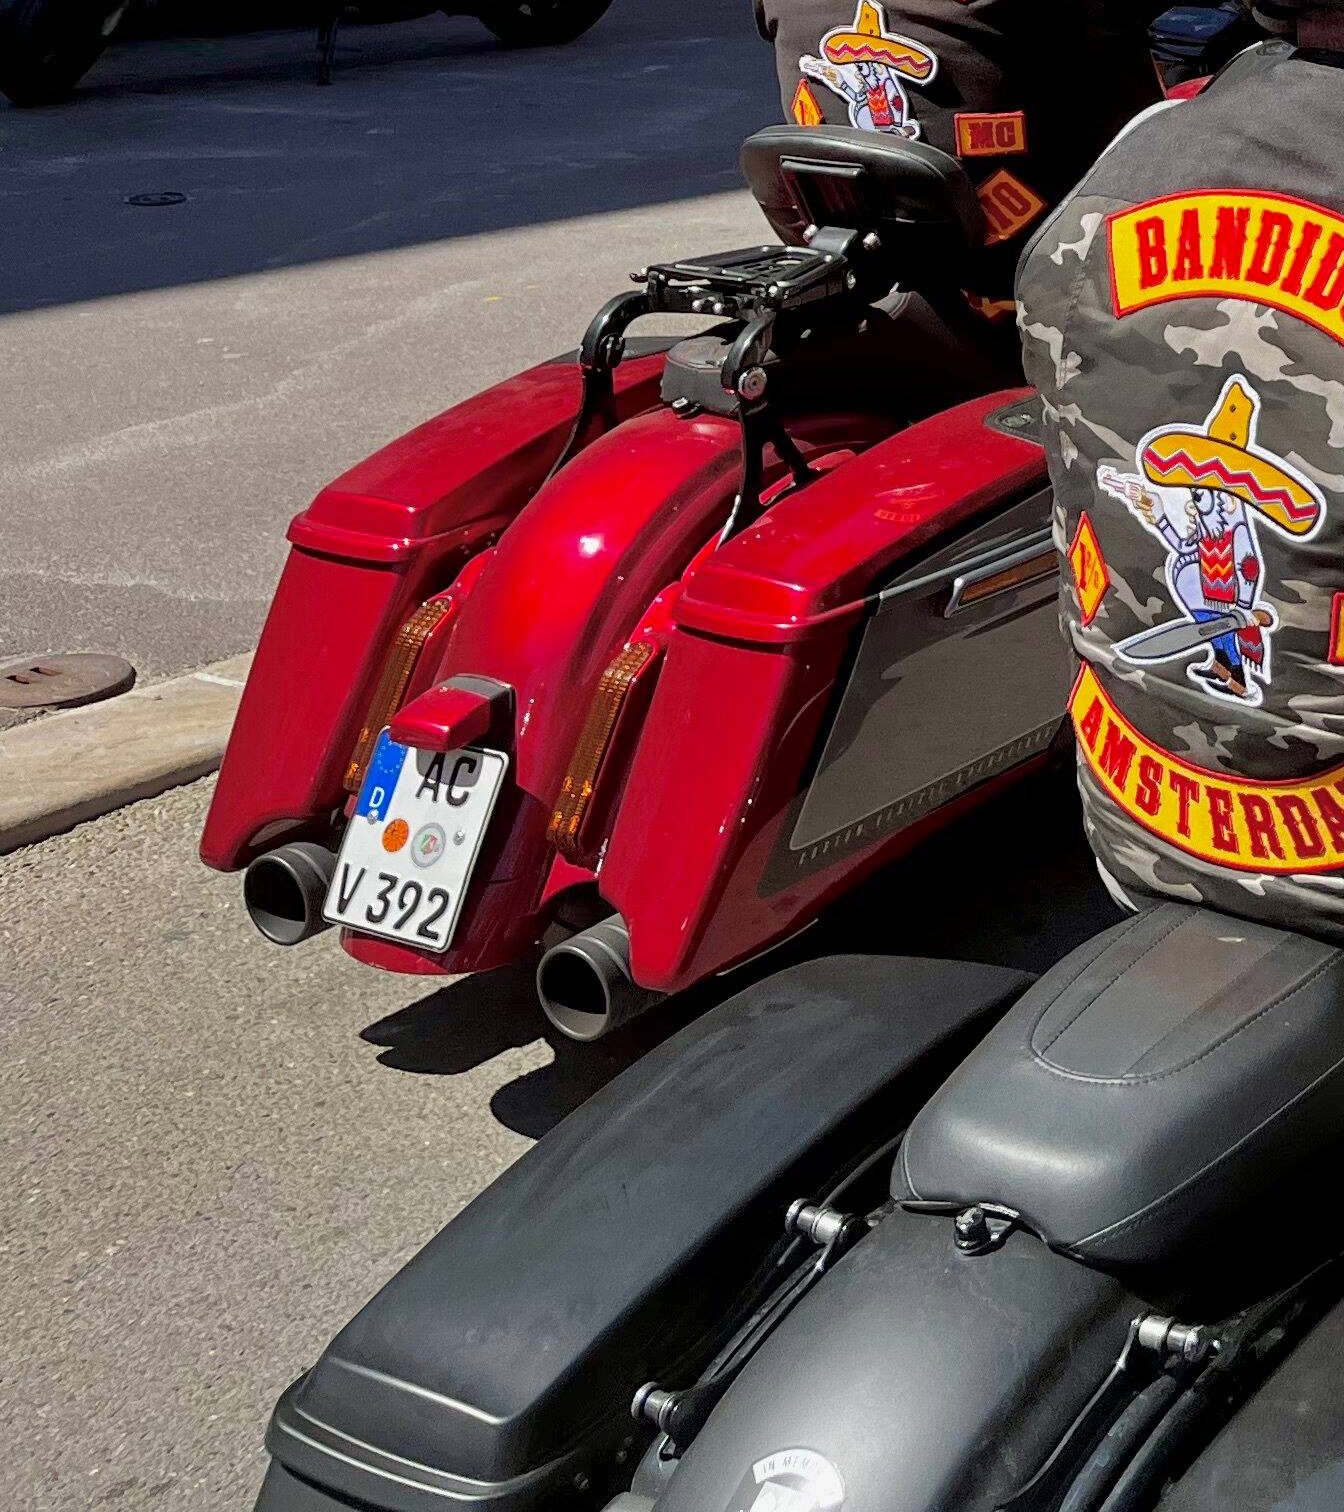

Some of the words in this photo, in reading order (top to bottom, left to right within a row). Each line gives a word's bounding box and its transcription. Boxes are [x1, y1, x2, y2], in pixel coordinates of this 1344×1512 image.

[967, 120, 1017, 150] MC
[368, 786, 385, 808] D
[415, 751, 478, 807] AC
[335, 862, 367, 916] V
[364, 871, 451, 941] 392
